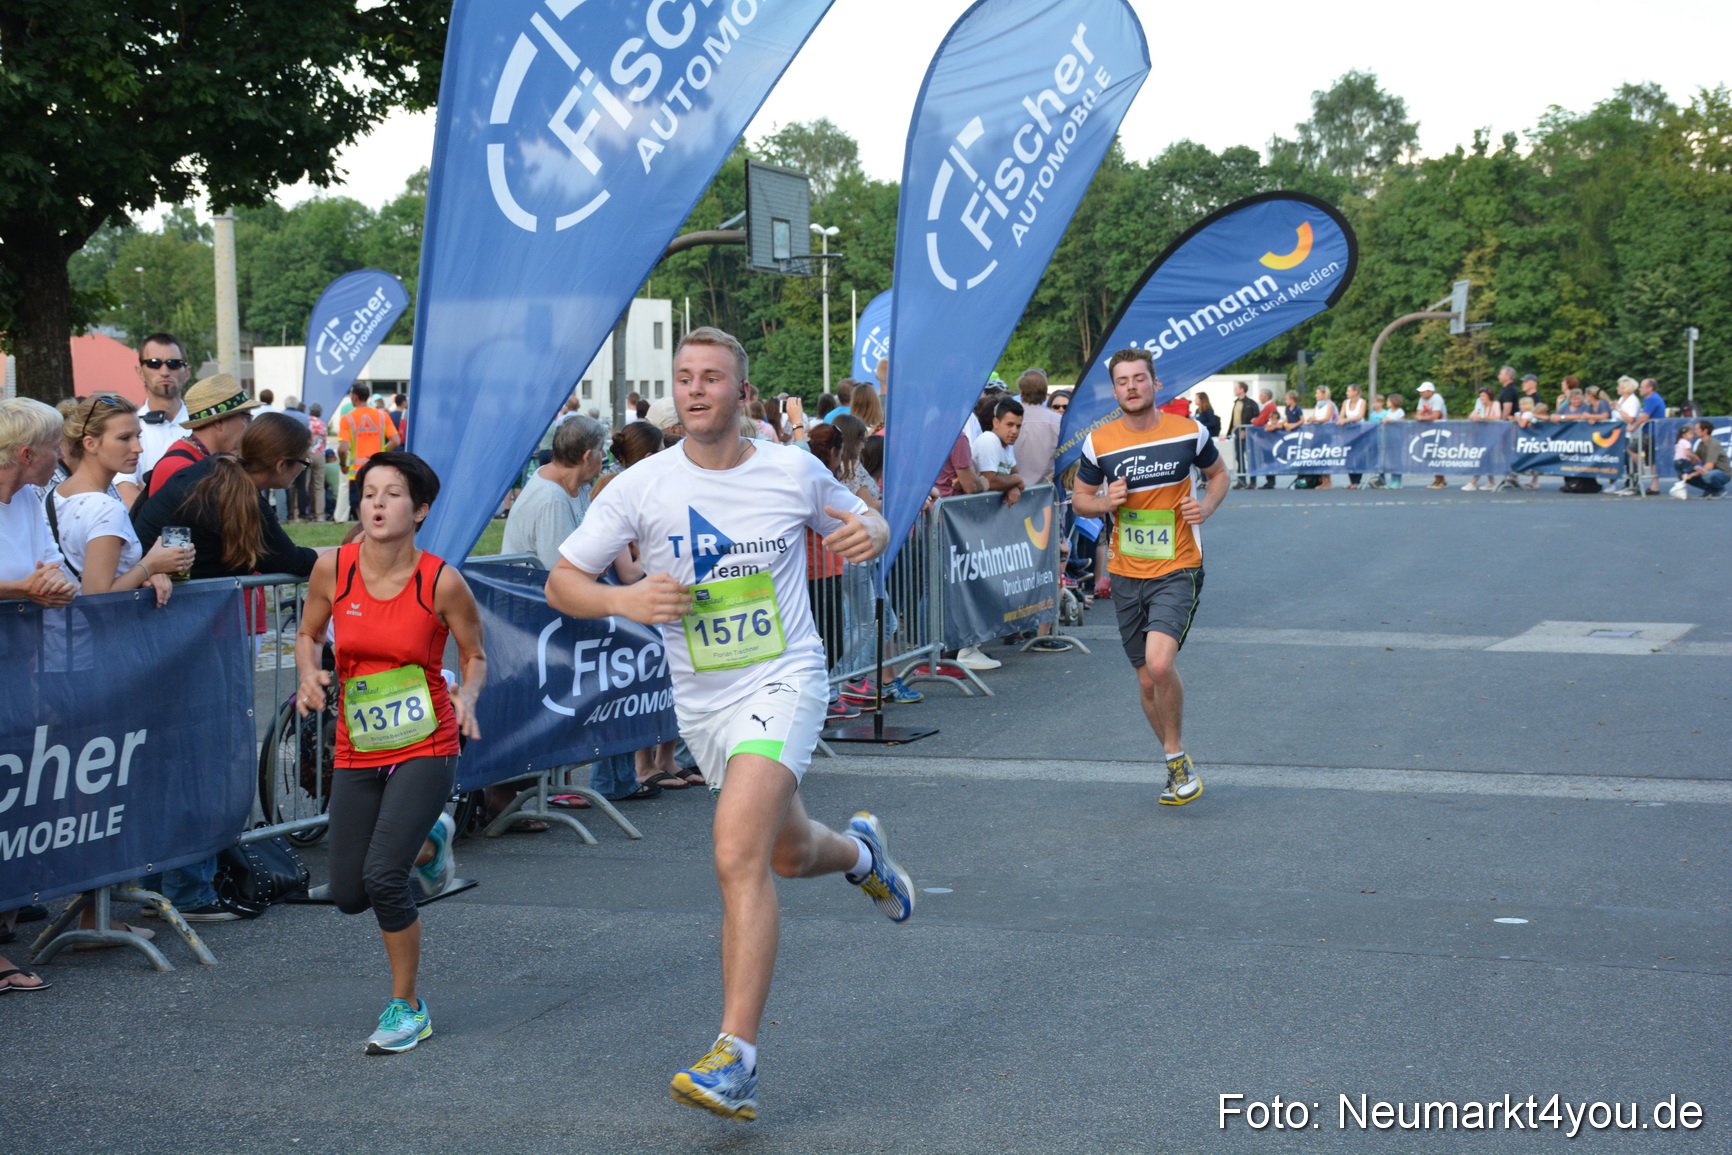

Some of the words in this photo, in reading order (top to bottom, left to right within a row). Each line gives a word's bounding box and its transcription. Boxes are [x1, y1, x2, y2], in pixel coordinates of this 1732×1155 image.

[547, 0, 714, 176] Fisc
[636, 0, 766, 174] AUTOMO
[960, 22, 1095, 251] Fischer
[1010, 65, 1112, 247] AUTOMOBILE
[1217, 306, 1260, 336] Druck
[1261, 293, 1288, 313] und
[1288, 260, 1339, 298] Medien
[329, 286, 386, 362] Fischer
[349, 301, 393, 361] AUTOMOBILE
[1103, 275, 1279, 369] schmann
[1287, 444, 1352, 460] Fischer
[1290, 458, 1346, 467] AUTOMOBILE
[1422, 443, 1487, 459] Fischer
[1516, 437, 1595, 454] Frischmann
[1125, 460, 1180, 477] Fischer
[1130, 470, 1176, 482] AUTOMOBILE
[697, 532, 788, 556] Running
[1125, 527, 1169, 545] 1614
[711, 563, 760, 579] Team
[950, 539, 1033, 584] Frischmann
[1003, 575, 1023, 597] Druck
[694, 608, 772, 647] 1576
[353, 696, 425, 732] 1378
[583, 688, 676, 726] AUTOMOB
